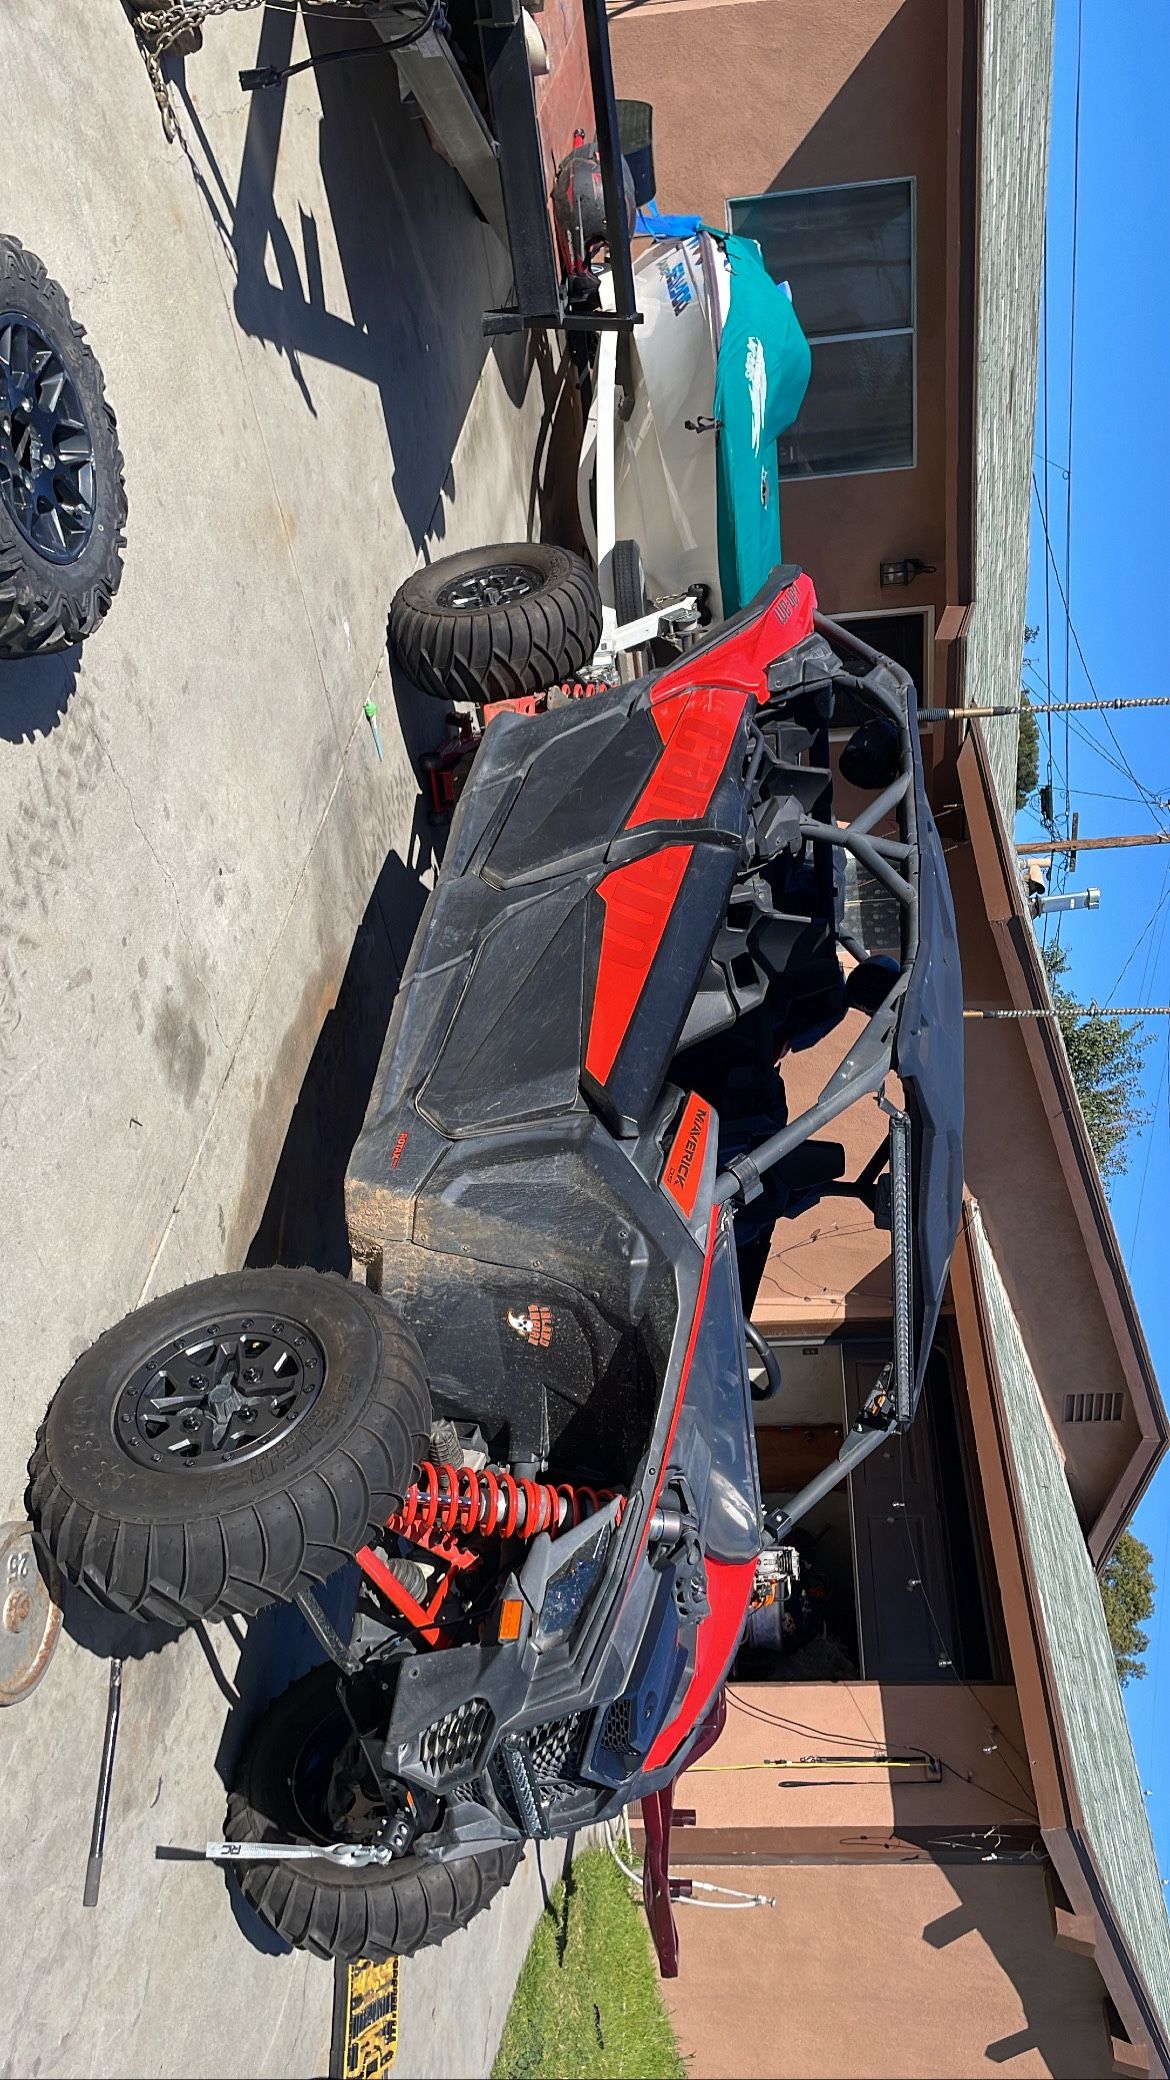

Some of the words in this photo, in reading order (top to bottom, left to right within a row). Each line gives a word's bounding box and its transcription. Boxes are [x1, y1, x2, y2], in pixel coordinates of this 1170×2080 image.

[392, 1132, 409, 1159] ROTAX
[674, 1108, 707, 1189] MAVERICK
[8, 1552, 30, 1585] 25
